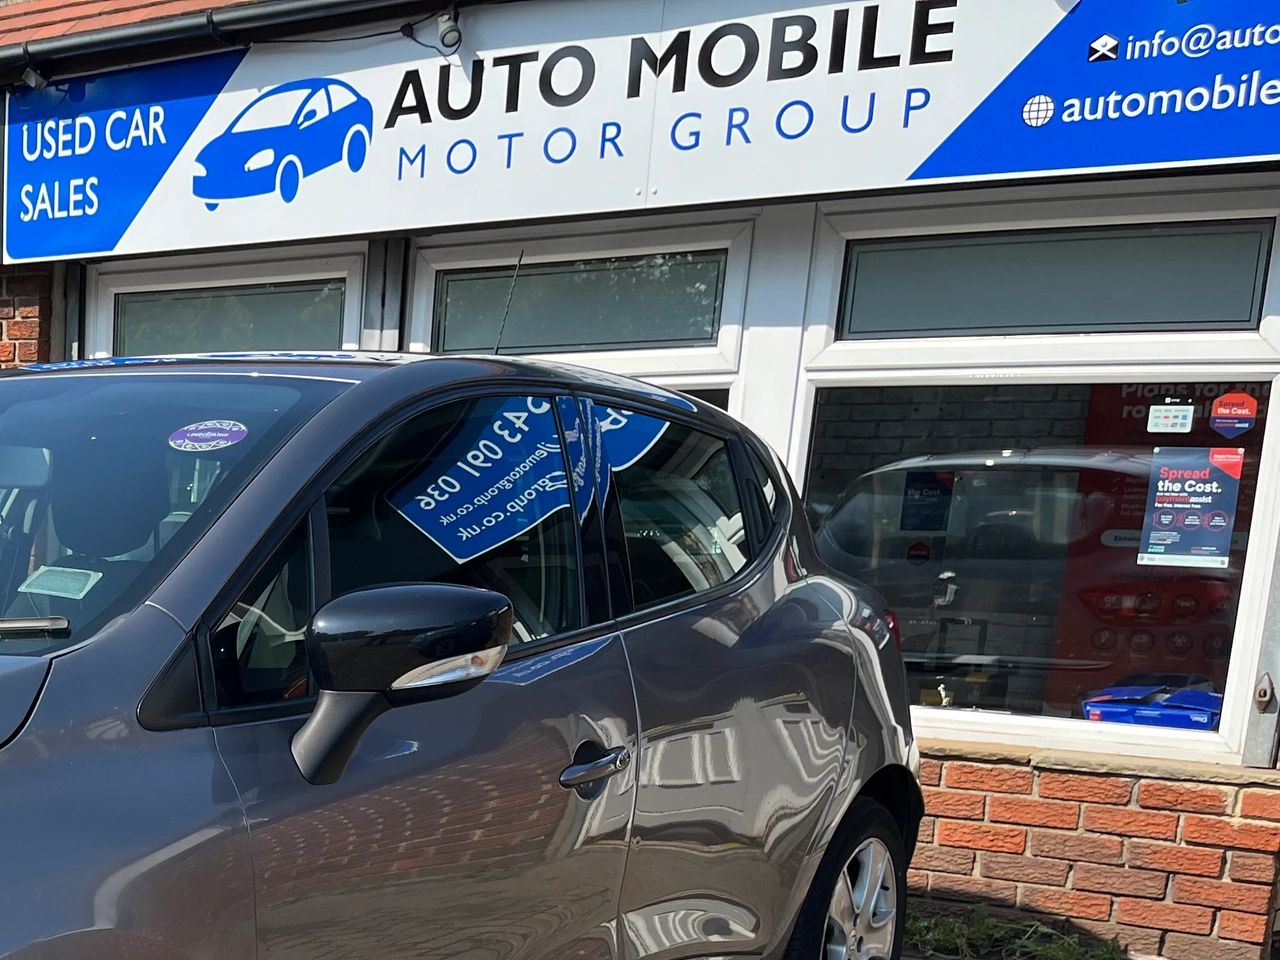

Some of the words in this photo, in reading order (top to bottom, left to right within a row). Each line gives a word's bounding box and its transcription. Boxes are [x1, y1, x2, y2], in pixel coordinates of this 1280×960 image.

[383, 45, 596, 129] AUTO
[626, 0, 958, 99] MOBILE
[1062, 70, 1280, 123] automobile
[22, 115, 96, 162] USED
[105, 105, 167, 151] CAR
[397, 121, 624, 181] MOTOR
[670, 87, 931, 151] GROUP
[20, 176, 99, 222] SALES
[1157, 480, 1182, 492] the
[1184, 480, 1222, 493] Cost.
[1160, 467, 1210, 480] Spread
